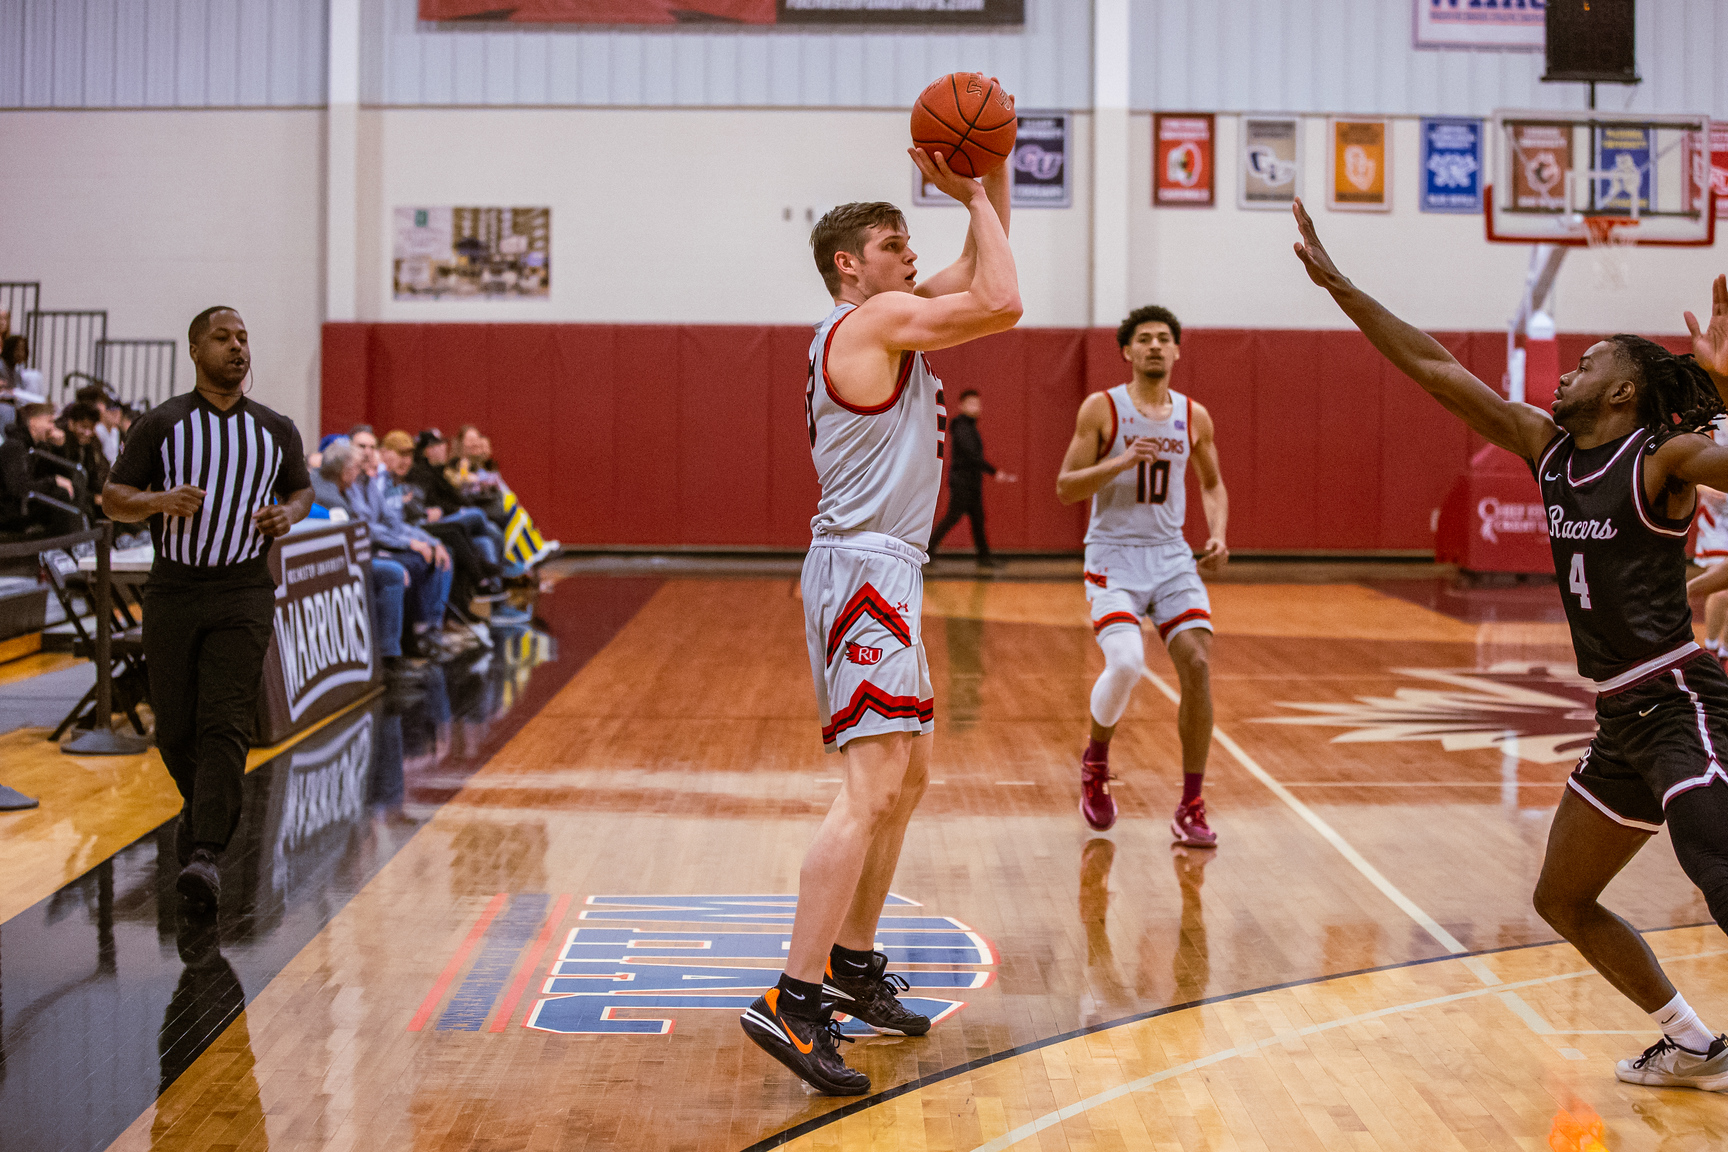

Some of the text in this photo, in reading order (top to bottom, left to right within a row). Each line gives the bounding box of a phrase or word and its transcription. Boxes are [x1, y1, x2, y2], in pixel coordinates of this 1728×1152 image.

[1136, 459, 1171, 505] 10
[1548, 504, 1618, 540] Racers
[1569, 552, 1592, 611] 4
[274, 581, 369, 701] WARRIORS
[858, 647, 883, 664] RU
